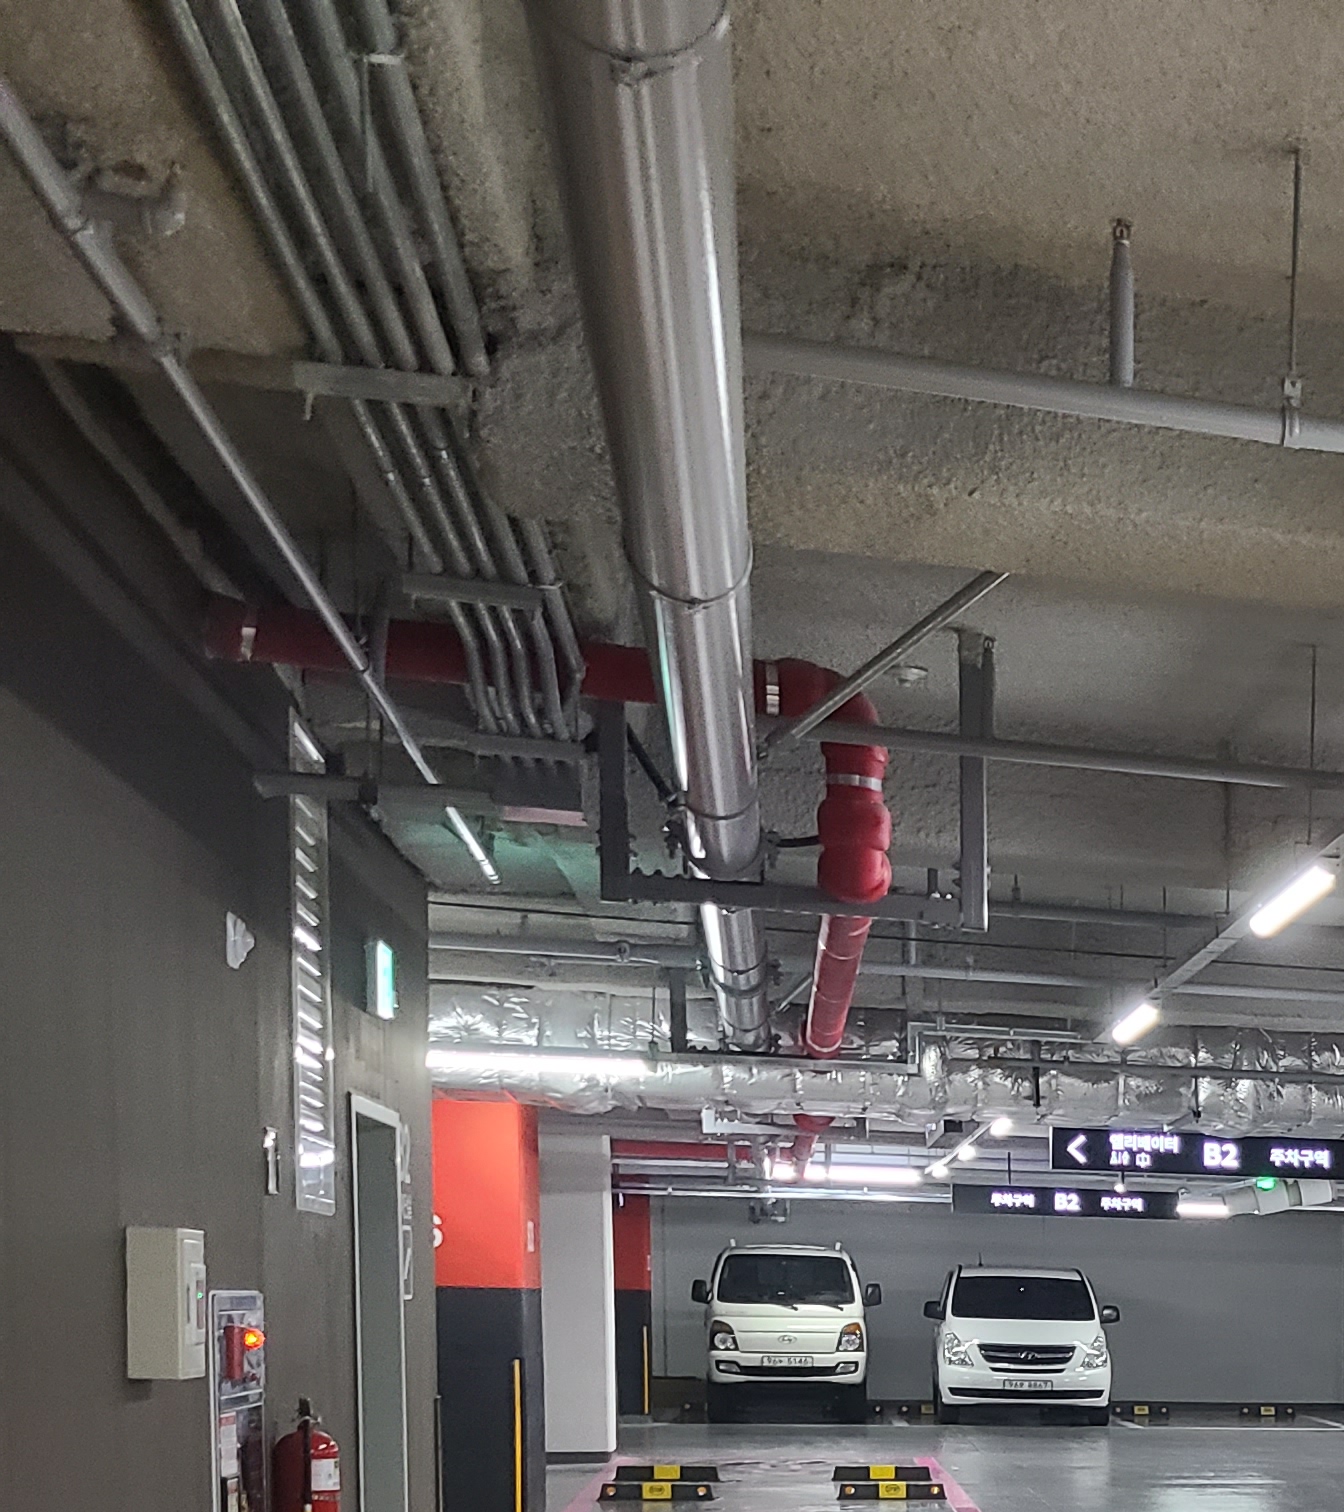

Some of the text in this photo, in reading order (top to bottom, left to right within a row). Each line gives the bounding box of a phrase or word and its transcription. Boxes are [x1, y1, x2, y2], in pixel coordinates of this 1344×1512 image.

[1203, 1142, 1240, 1169] B2
[1269, 1148, 1331, 1169] 주차구역
[990, 1192, 1035, 1208] 주차구역
[1054, 1192, 1081, 1211] B2
[1101, 1196, 1144, 1213] 주차구역
